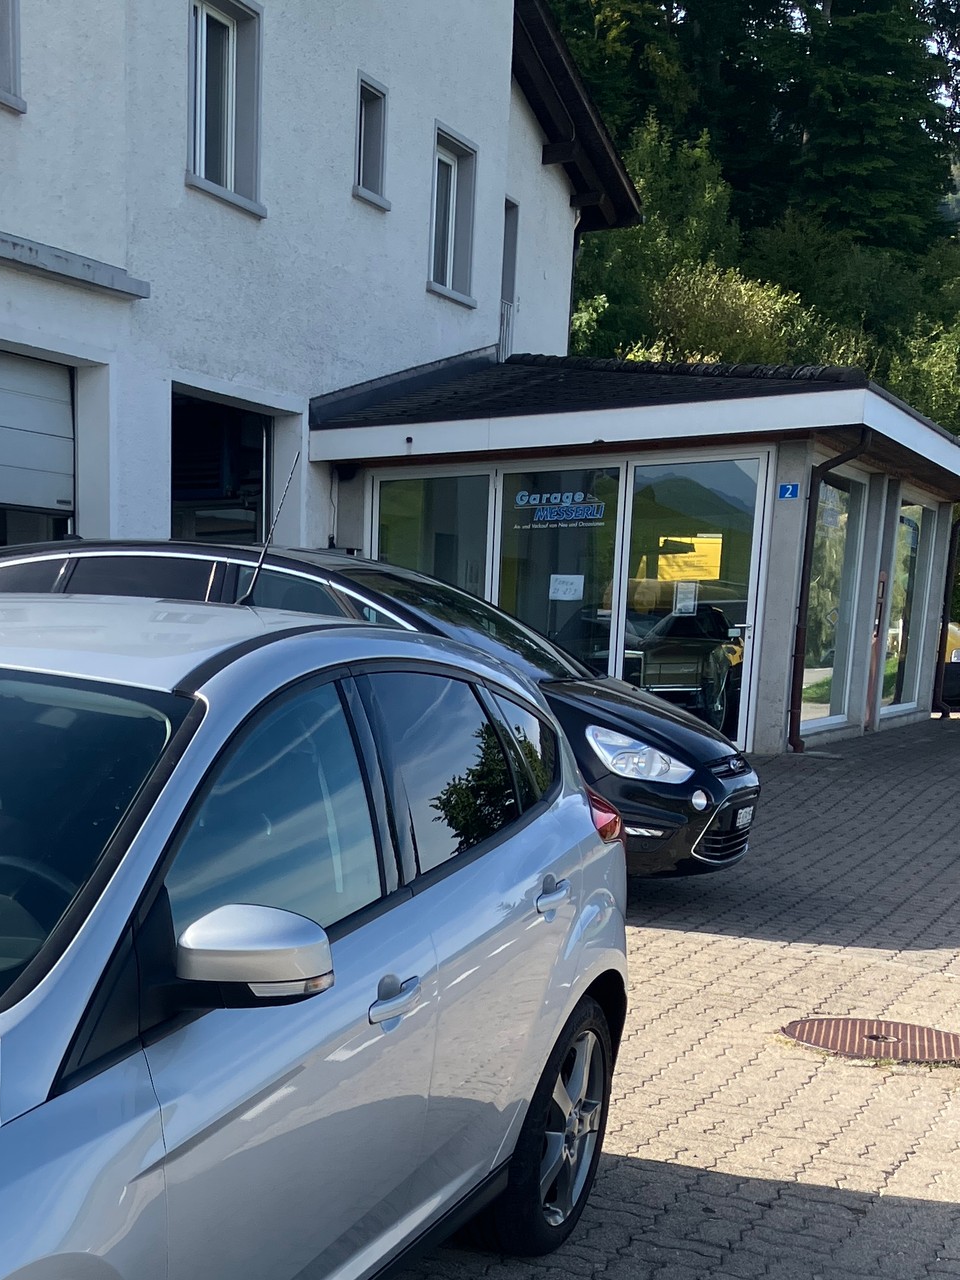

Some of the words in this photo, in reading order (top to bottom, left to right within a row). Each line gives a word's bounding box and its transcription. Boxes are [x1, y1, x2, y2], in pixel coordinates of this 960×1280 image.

[515, 490, 585, 506] Garage
[784, 484, 793, 498] 2
[533, 504, 605, 521] MESSERLI
